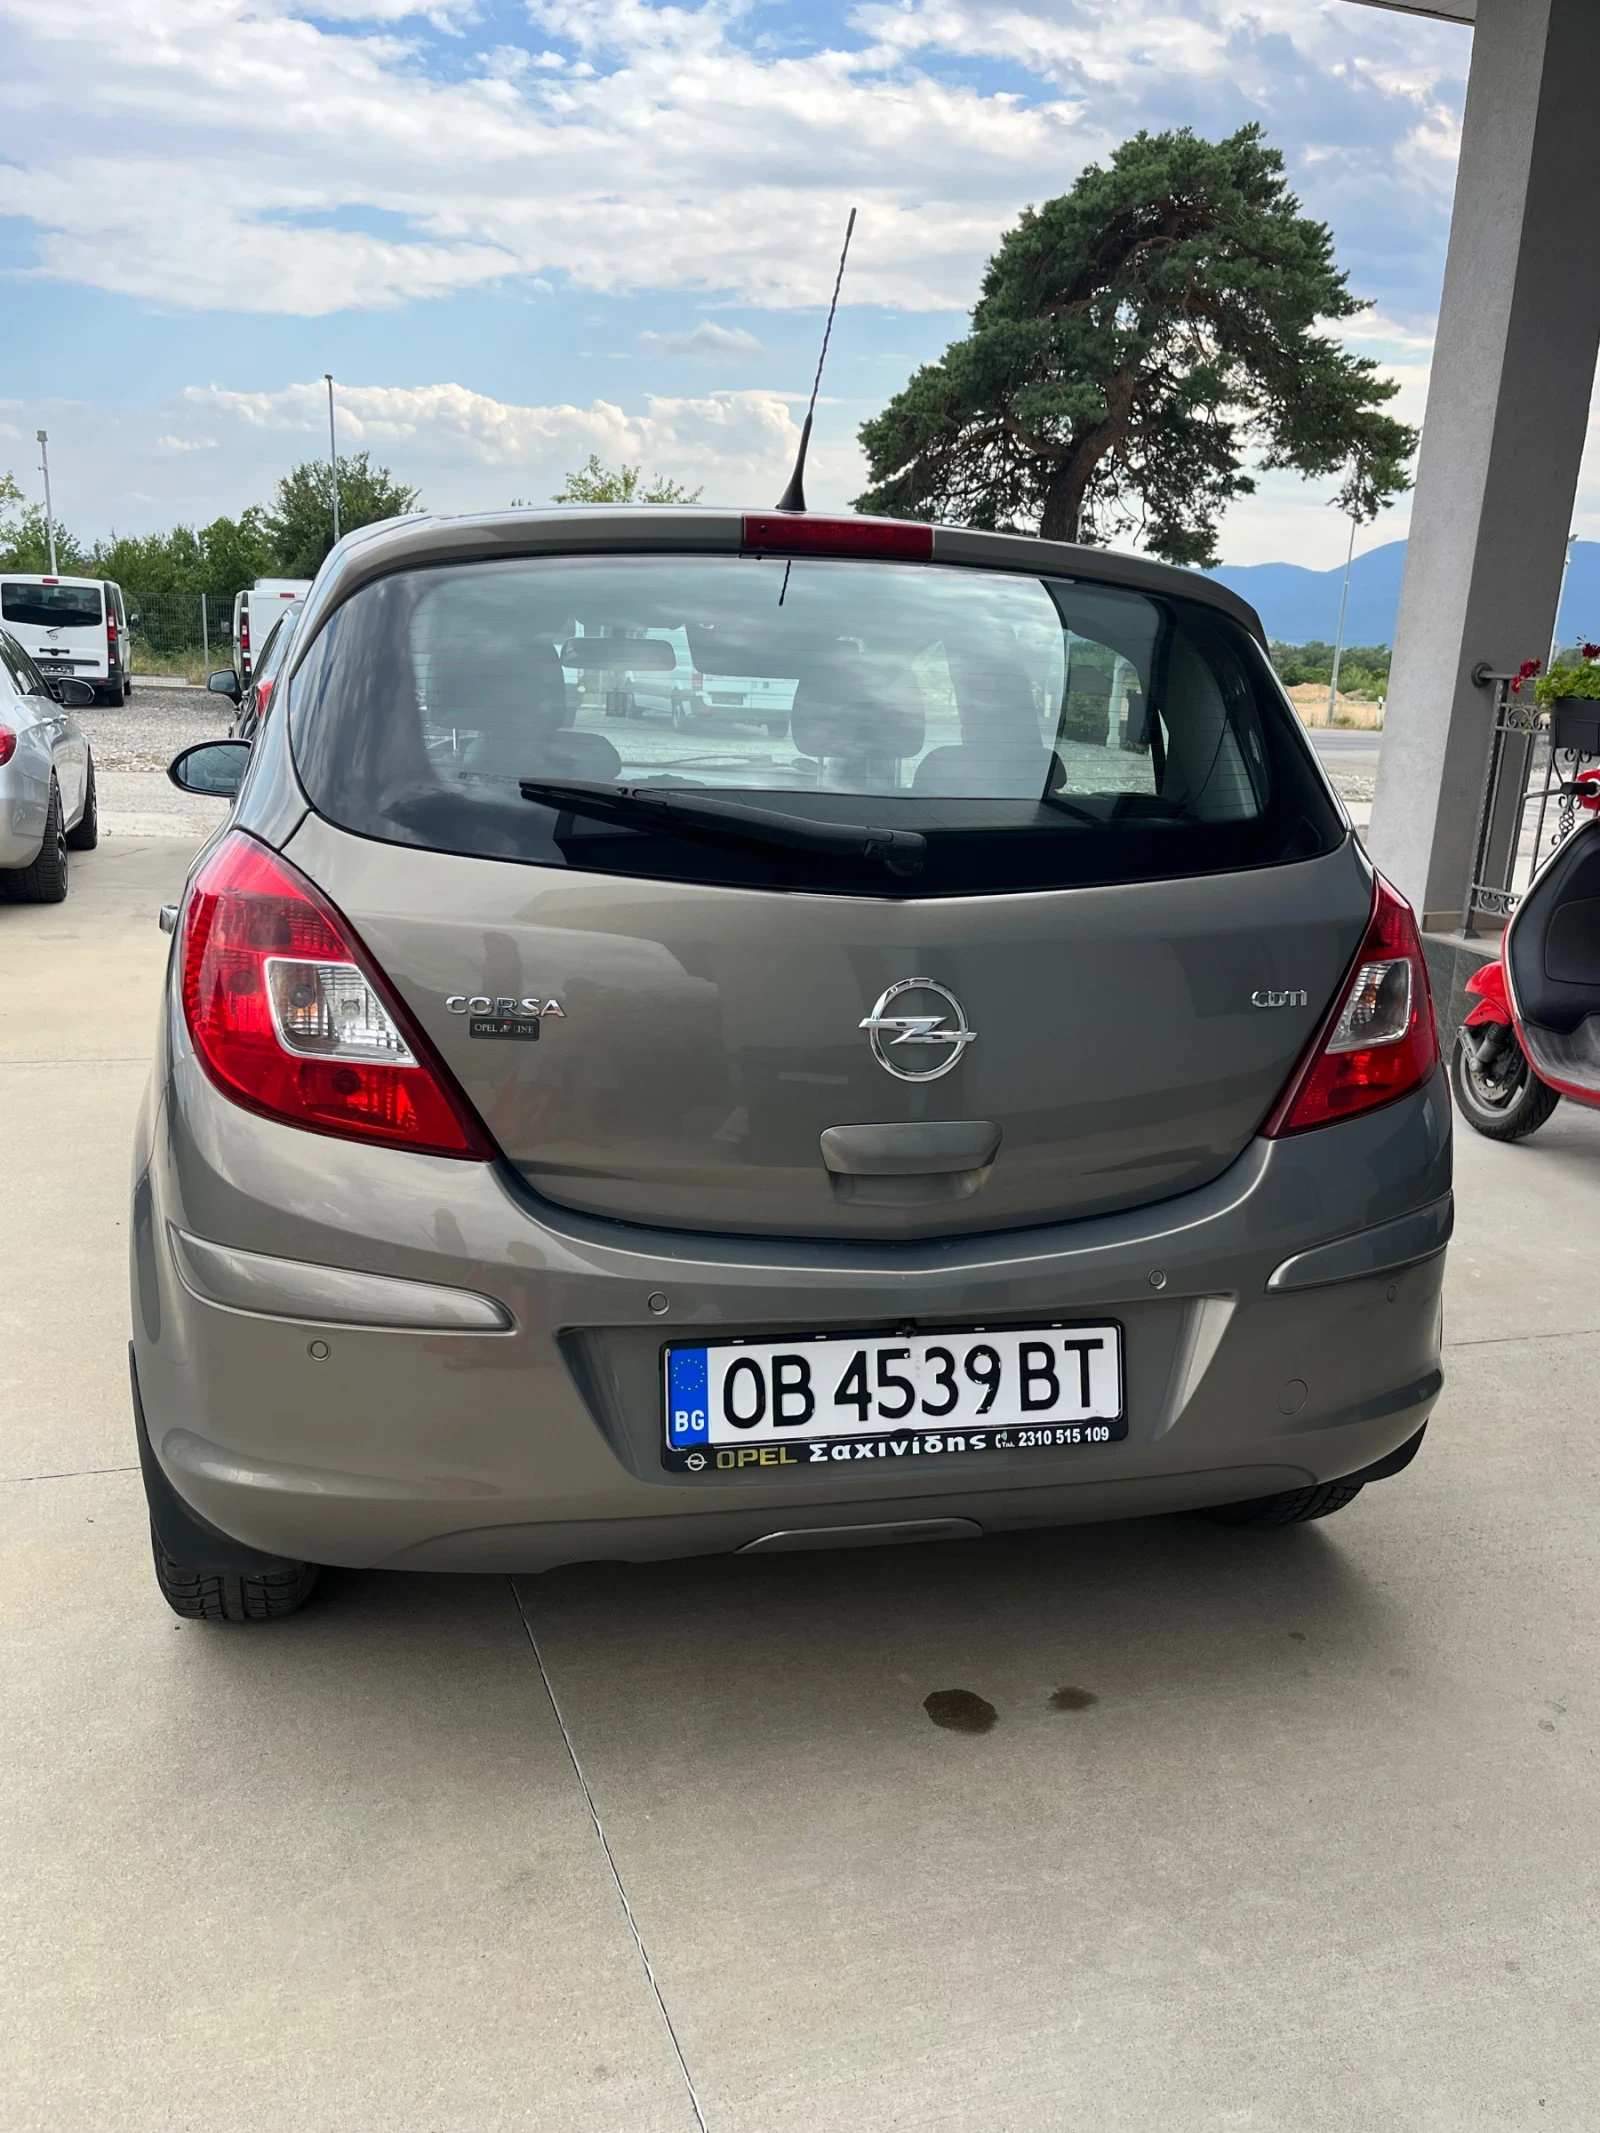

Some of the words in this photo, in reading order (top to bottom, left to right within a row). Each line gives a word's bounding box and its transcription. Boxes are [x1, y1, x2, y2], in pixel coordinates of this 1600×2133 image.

[445, 995, 567, 1017] CORSA
[1251, 989, 1308, 1007] CDTI
[474, 1023, 498, 1033] OPEL
[722, 1354, 815, 1429] OB
[833, 1344, 1002, 1422] 4539
[1018, 1337, 1105, 1413] BT
[674, 1410, 705, 1432] BG
[1018, 1430, 1052, 1447] 2310
[1055, 1428, 1081, 1444] 515
[1084, 1426, 1110, 1442] 109
[716, 1447, 798, 1470] OPEL
[809, 1434, 987, 1463] Σαχινίδης
